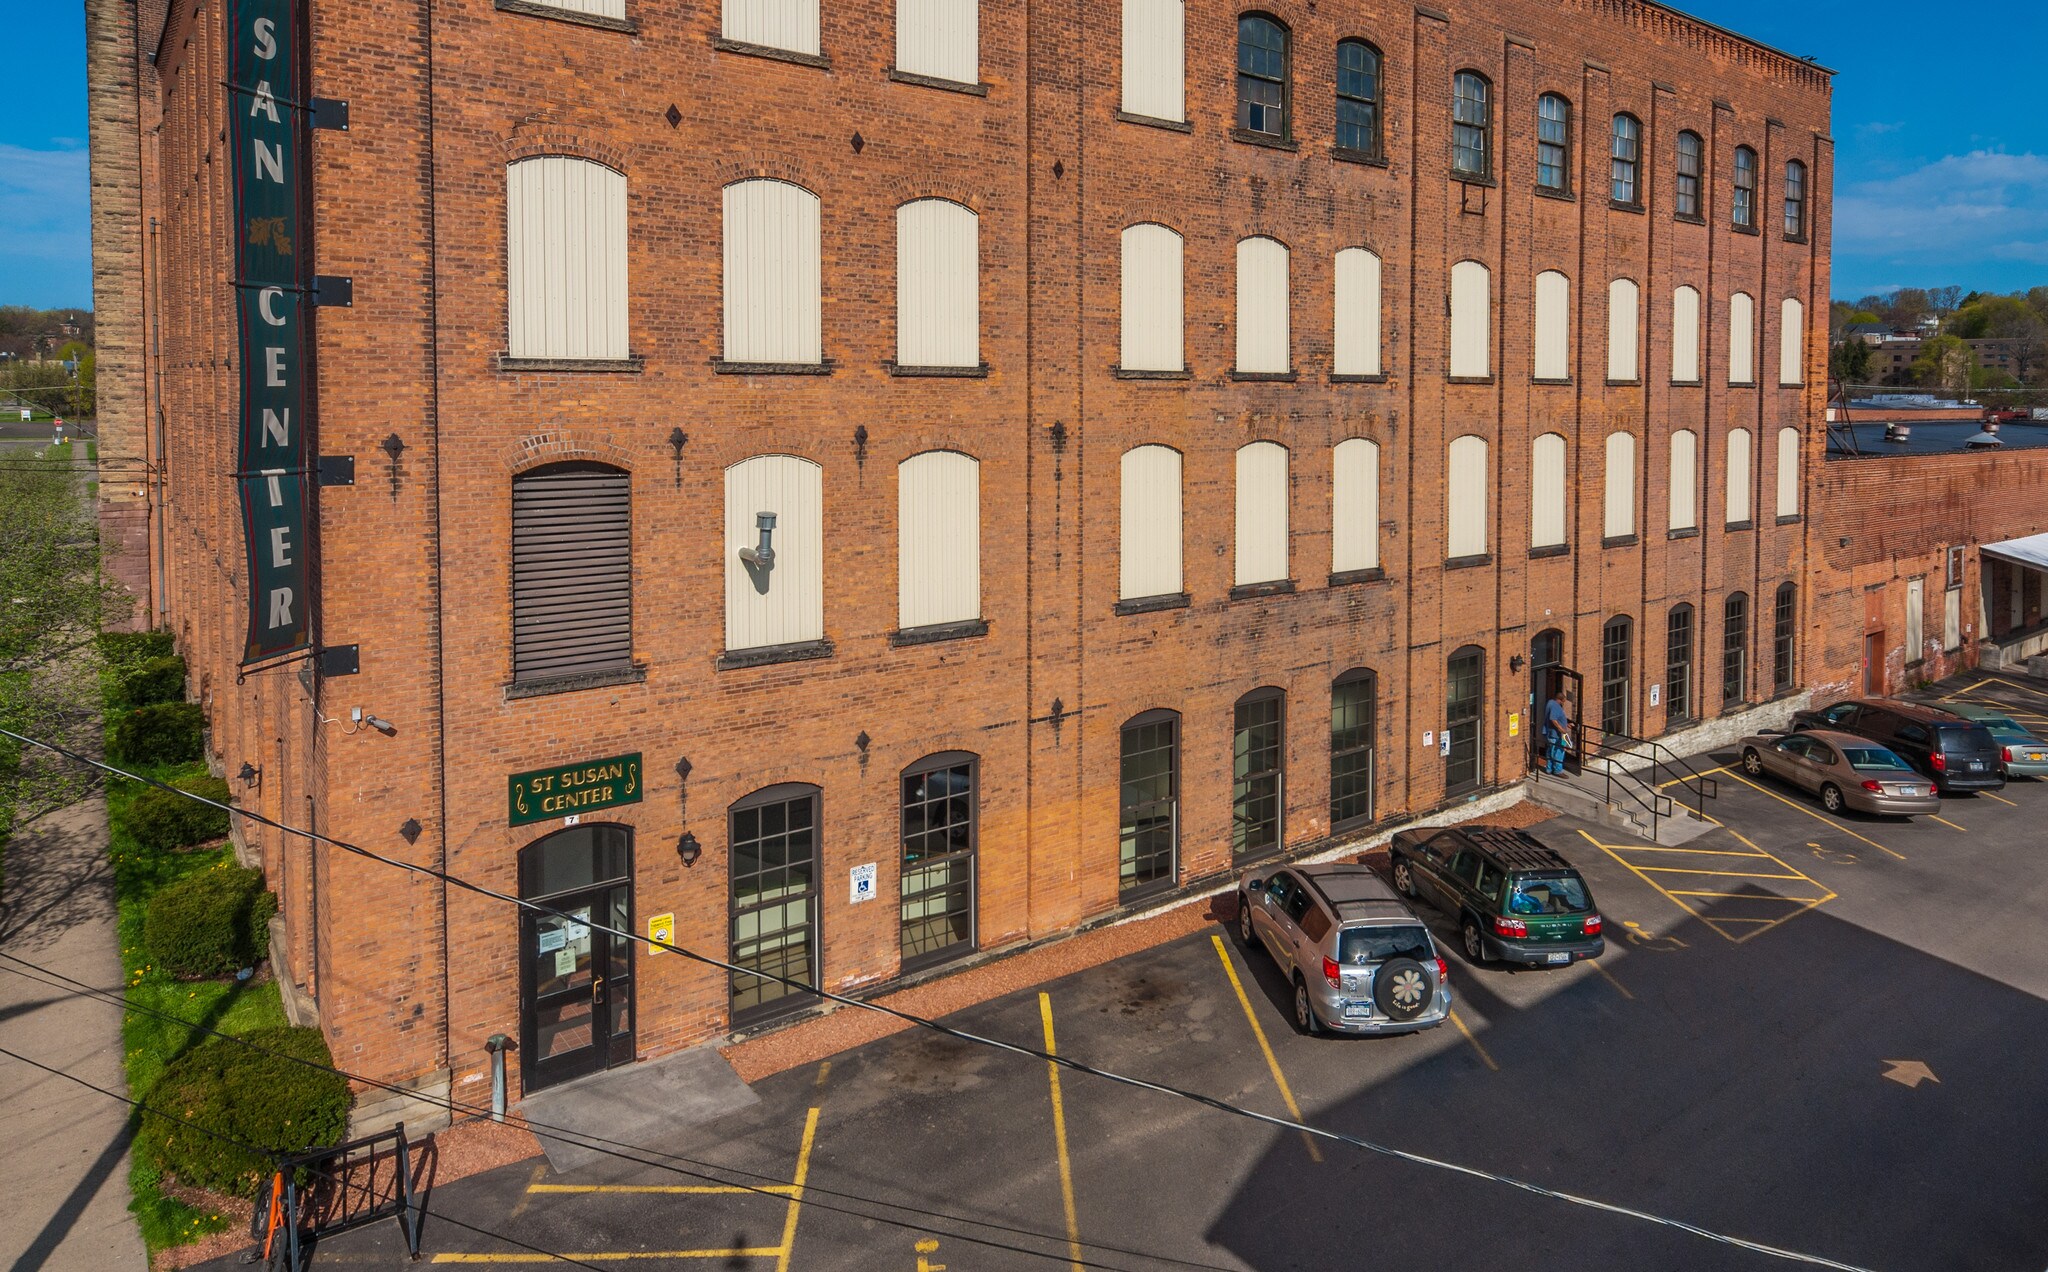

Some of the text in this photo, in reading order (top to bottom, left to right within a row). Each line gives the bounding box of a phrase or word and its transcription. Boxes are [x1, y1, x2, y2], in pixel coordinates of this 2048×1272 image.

[250, 17, 293, 629] SAN CENTER
[530, 764, 623, 794] ST SUSAN
[541, 787, 613, 813] CENTER
[568, 816, 575, 824] 7
